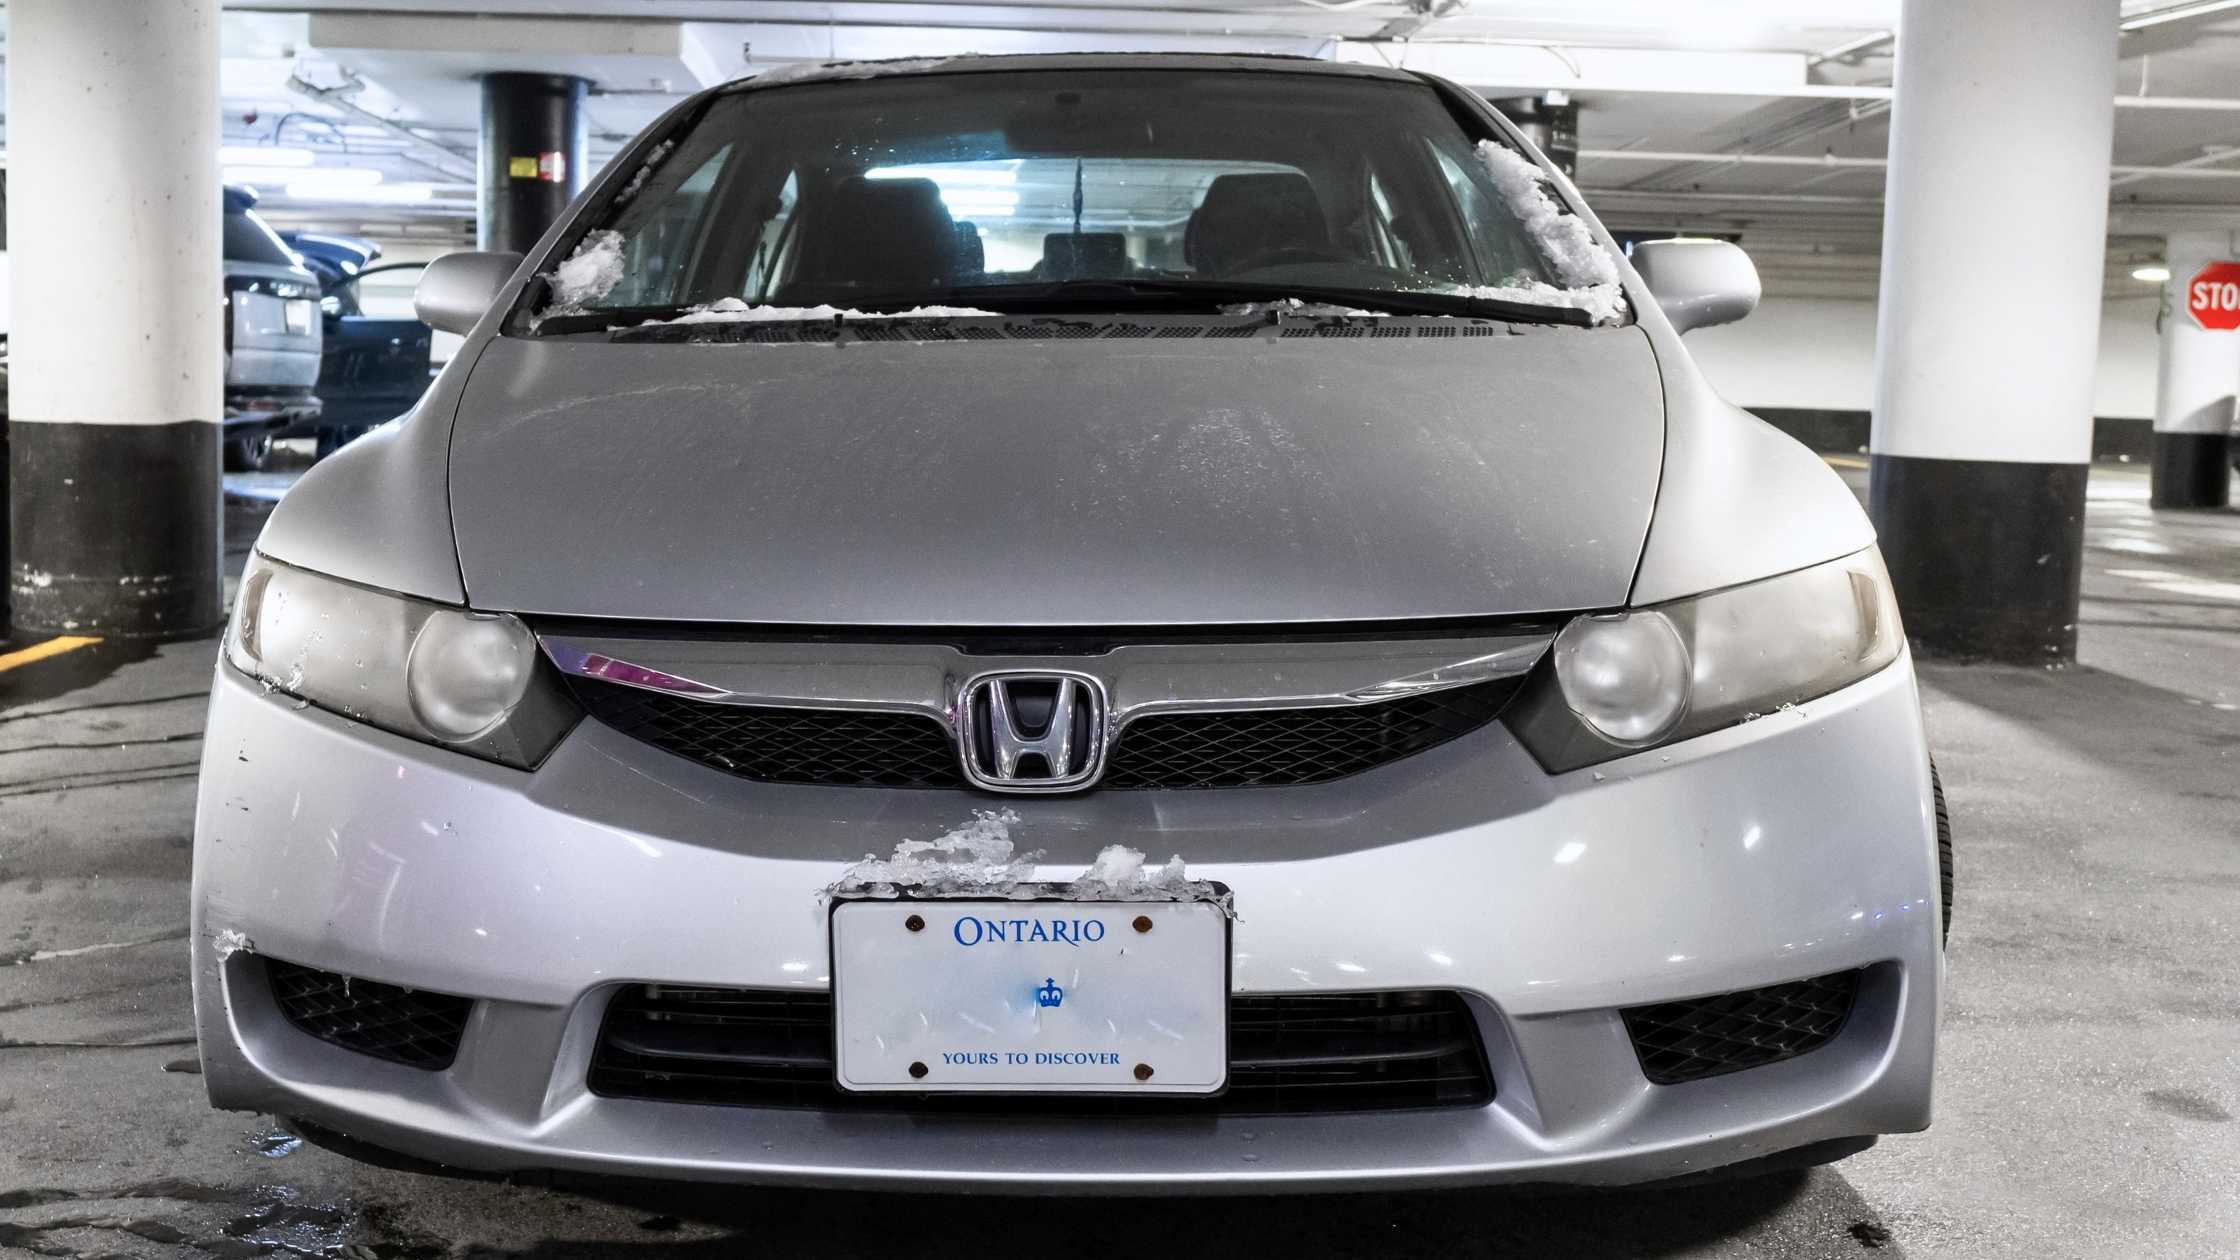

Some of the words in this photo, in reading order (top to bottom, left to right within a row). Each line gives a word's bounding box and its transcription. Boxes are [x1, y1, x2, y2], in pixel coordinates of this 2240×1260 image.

[2191, 281, 2240, 311] STO
[954, 916, 1105, 947] ONTARIO
[943, 1052, 999, 1065] YOURS
[1005, 1052, 1029, 1065] TO
[1035, 1052, 1121, 1065] DISCOVER
